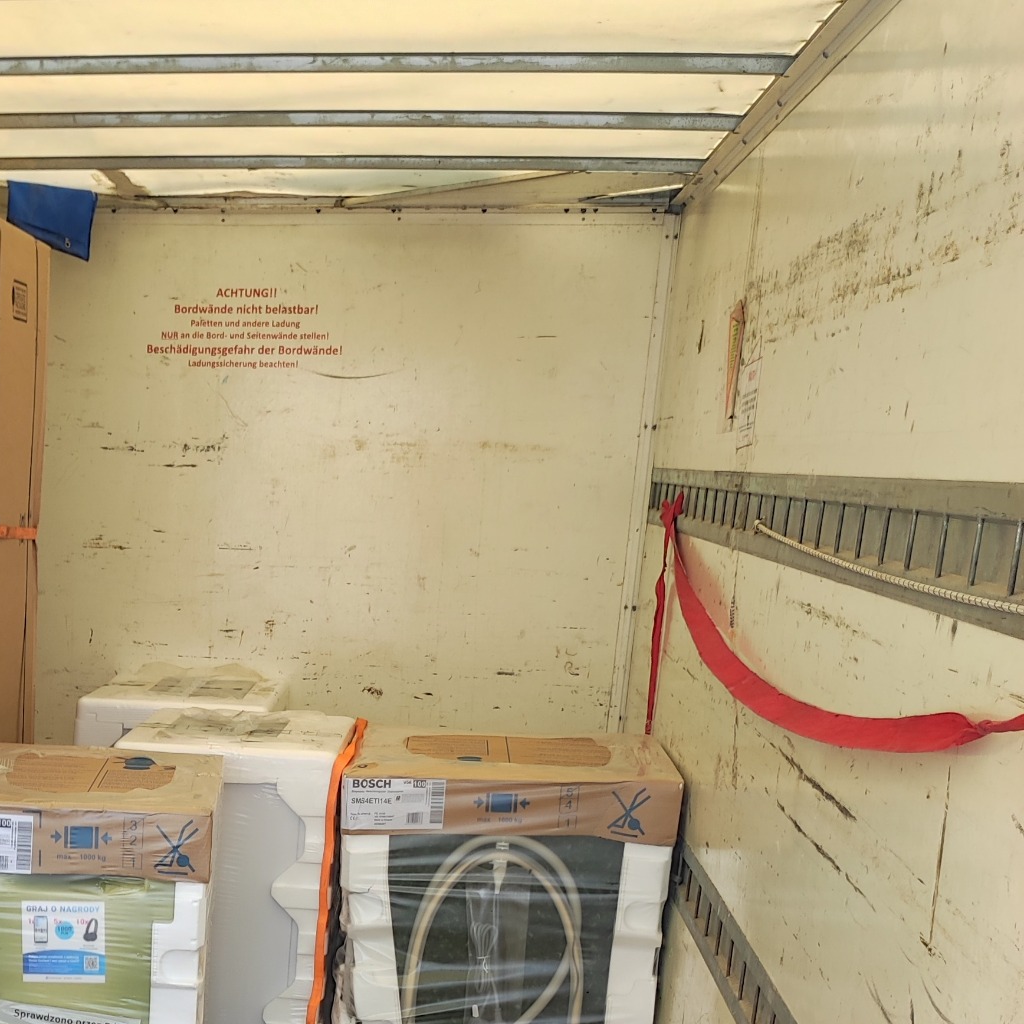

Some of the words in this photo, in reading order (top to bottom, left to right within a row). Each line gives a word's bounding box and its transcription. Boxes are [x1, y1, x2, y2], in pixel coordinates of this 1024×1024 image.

[216, 288, 277, 298] ACHTUNG!!
[175, 304, 233, 314] Bordwände
[237, 304, 262, 314] nicht
[266, 304, 318, 315] belastbar!
[191, 320, 222, 328] Paletten
[225, 320, 240, 328] und
[242, 320, 269, 328] andere
[272, 320, 300, 329] Ladung
[161, 332, 178, 340] NUR
[206, 332, 228, 340] Bord-
[230, 332, 244, 340] und
[247, 332, 297, 340] Seitenwände
[300, 332, 329, 340] stellen!
[146, 345, 254, 356] Beschädigungsgefahr
[258, 345, 275, 355] der
[278, 345, 342, 356] Bordwände!
[188, 360, 257, 369] Ladungssicherung
[259, 360, 298, 369] beachten!
[352, 780, 391, 788] BOSCH
[414, 780, 426, 788] 100
[129, 837, 137, 846] 2
[98, 853, 106, 861] kg
[14, 1009, 73, 1024] Sprawdzono
